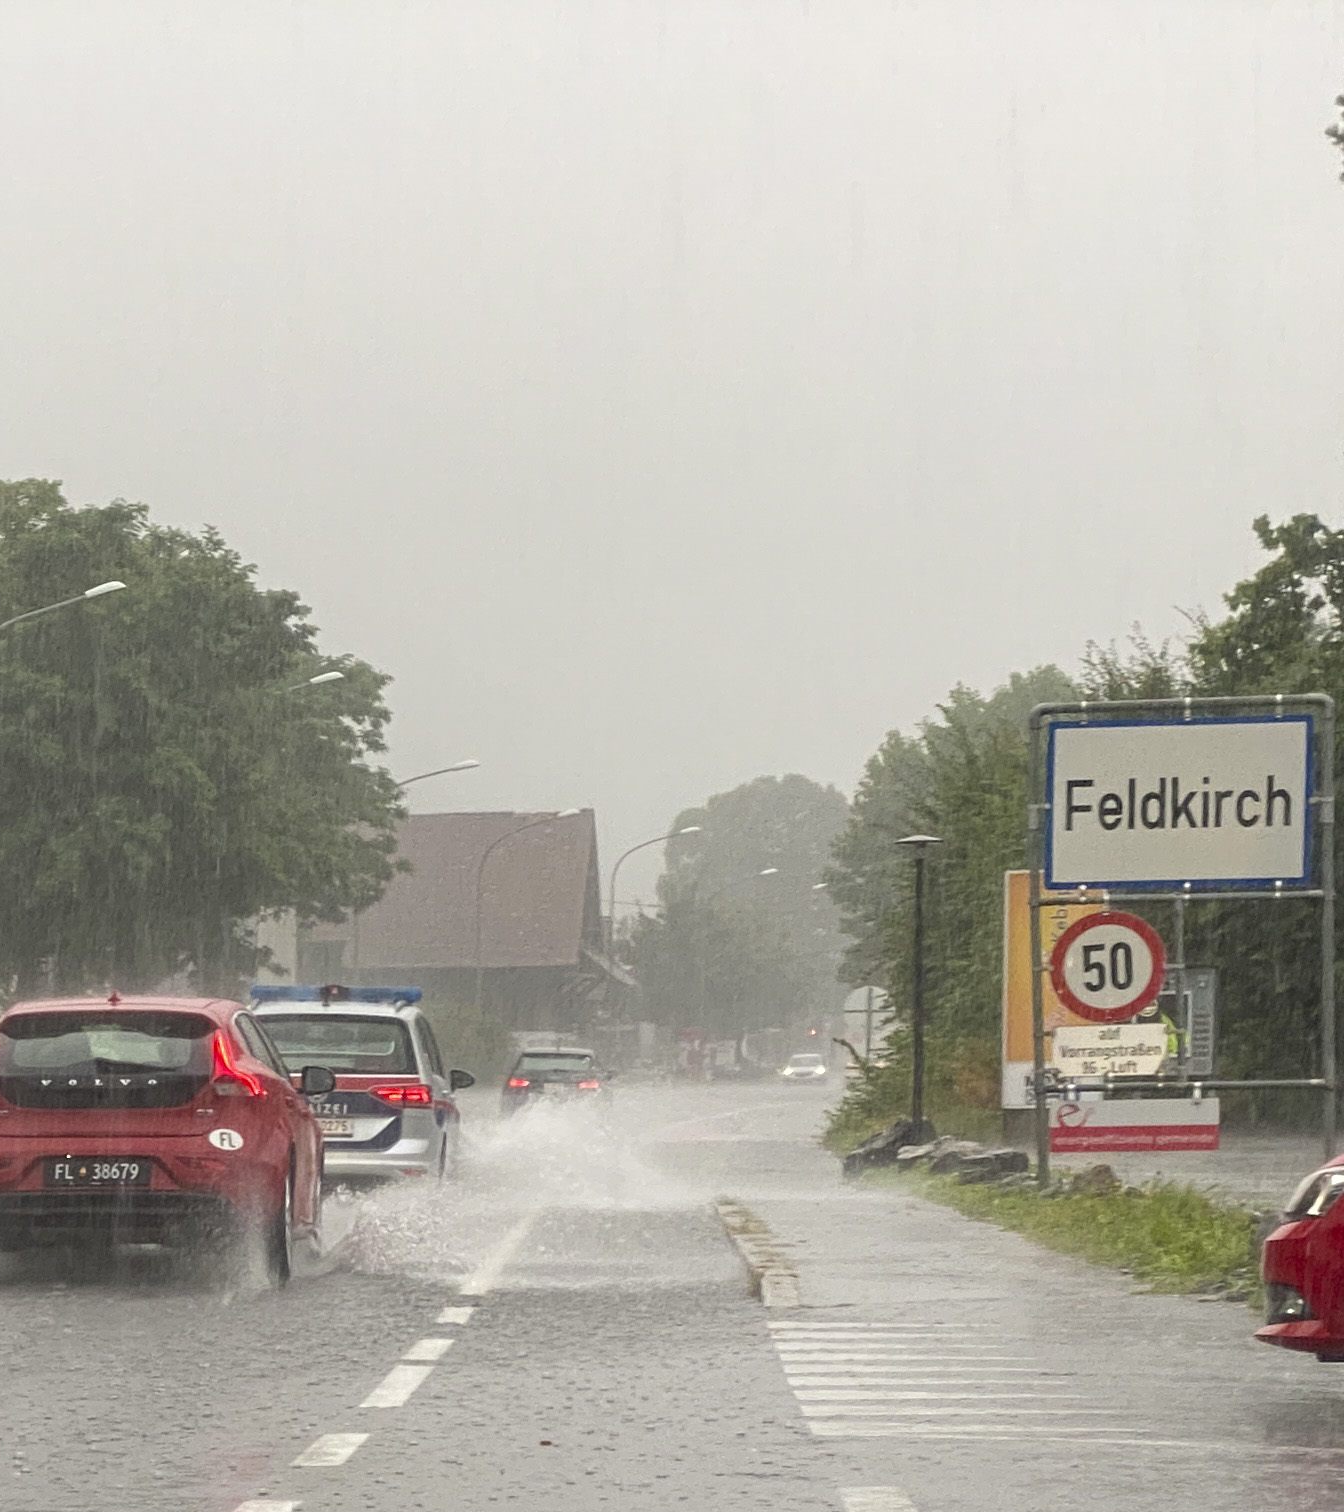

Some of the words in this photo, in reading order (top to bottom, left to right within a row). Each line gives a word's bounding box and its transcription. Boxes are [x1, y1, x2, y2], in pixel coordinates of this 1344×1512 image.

[1065, 774, 1293, 831] Feldkirch
[1082, 941, 1133, 992] 50
[1059, 1043, 1162, 1060] Vorrangstraßen
[1110, 1060, 1138, 1073] Luft
[40, 1078, 158, 1087] VOLVO
[308, 1103, 349, 1115] LIZEI
[219, 1132, 237, 1148] FL
[54, 1163, 75, 1180] FL
[92, 1163, 140, 1180] 38679
